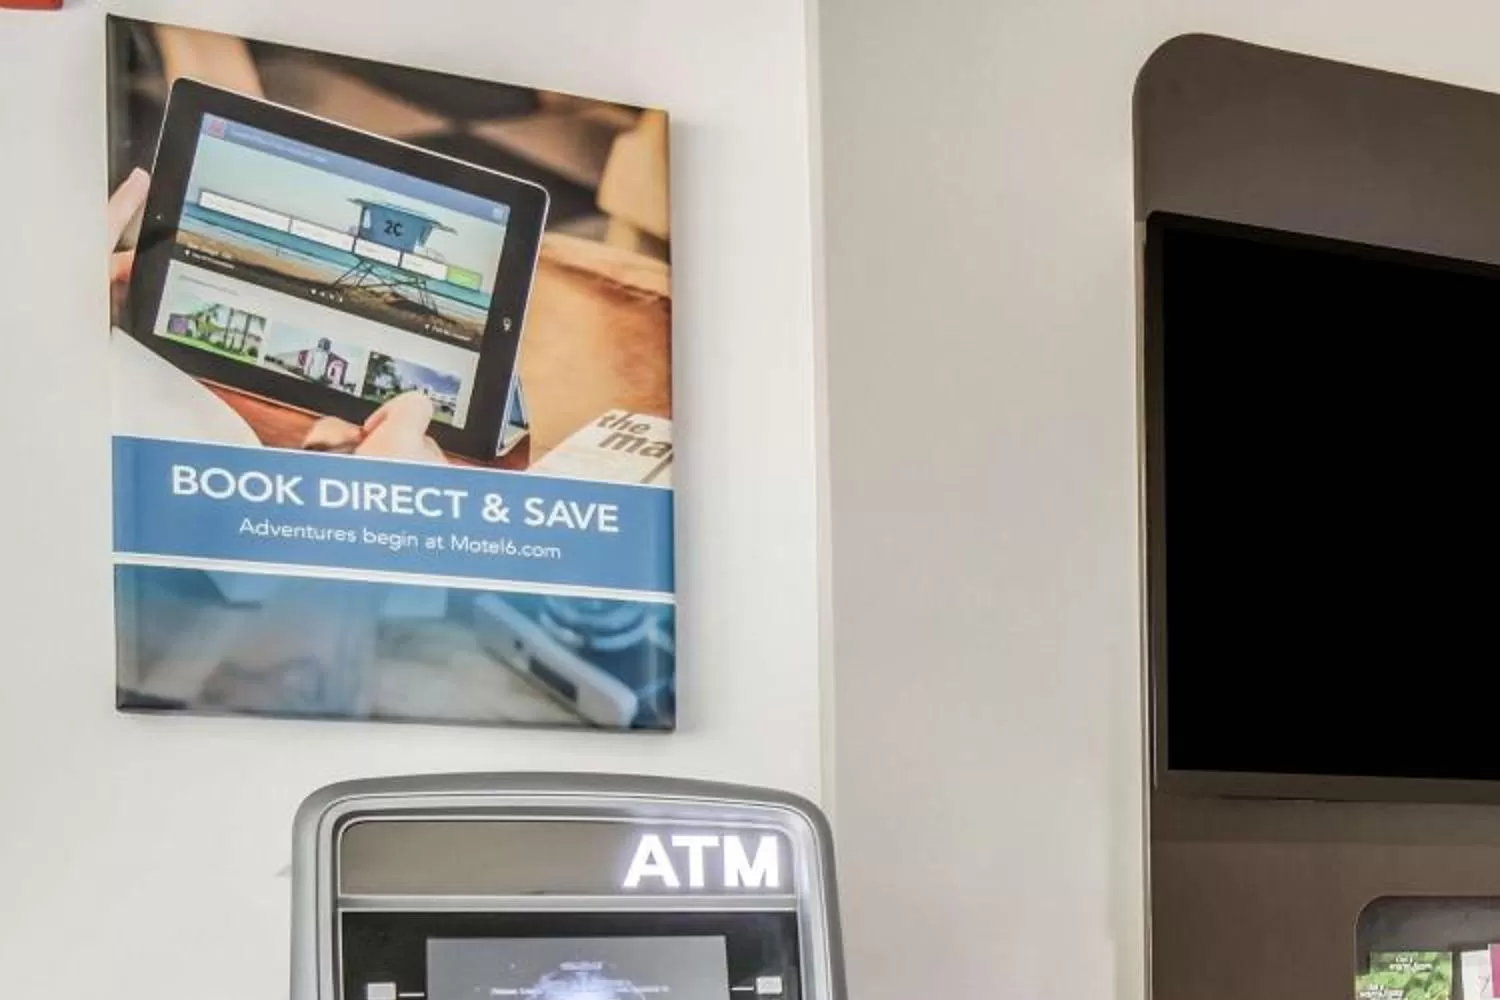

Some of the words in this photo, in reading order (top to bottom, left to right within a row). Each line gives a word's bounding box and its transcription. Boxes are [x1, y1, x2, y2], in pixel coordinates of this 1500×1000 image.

[383, 219, 404, 237] 2C
[596, 412, 651, 434] the
[598, 431, 673, 474] ma
[171, 464, 304, 507] BOOK
[319, 477, 468, 519] DIRECT
[480, 493, 511, 524] &
[523, 497, 620, 533] SAVE
[239, 517, 357, 543] Adventures
[362, 527, 419, 551] begin
[425, 535, 444, 550] at
[450, 534, 562, 560] Motel6.com
[624, 834, 780, 888] ATM
